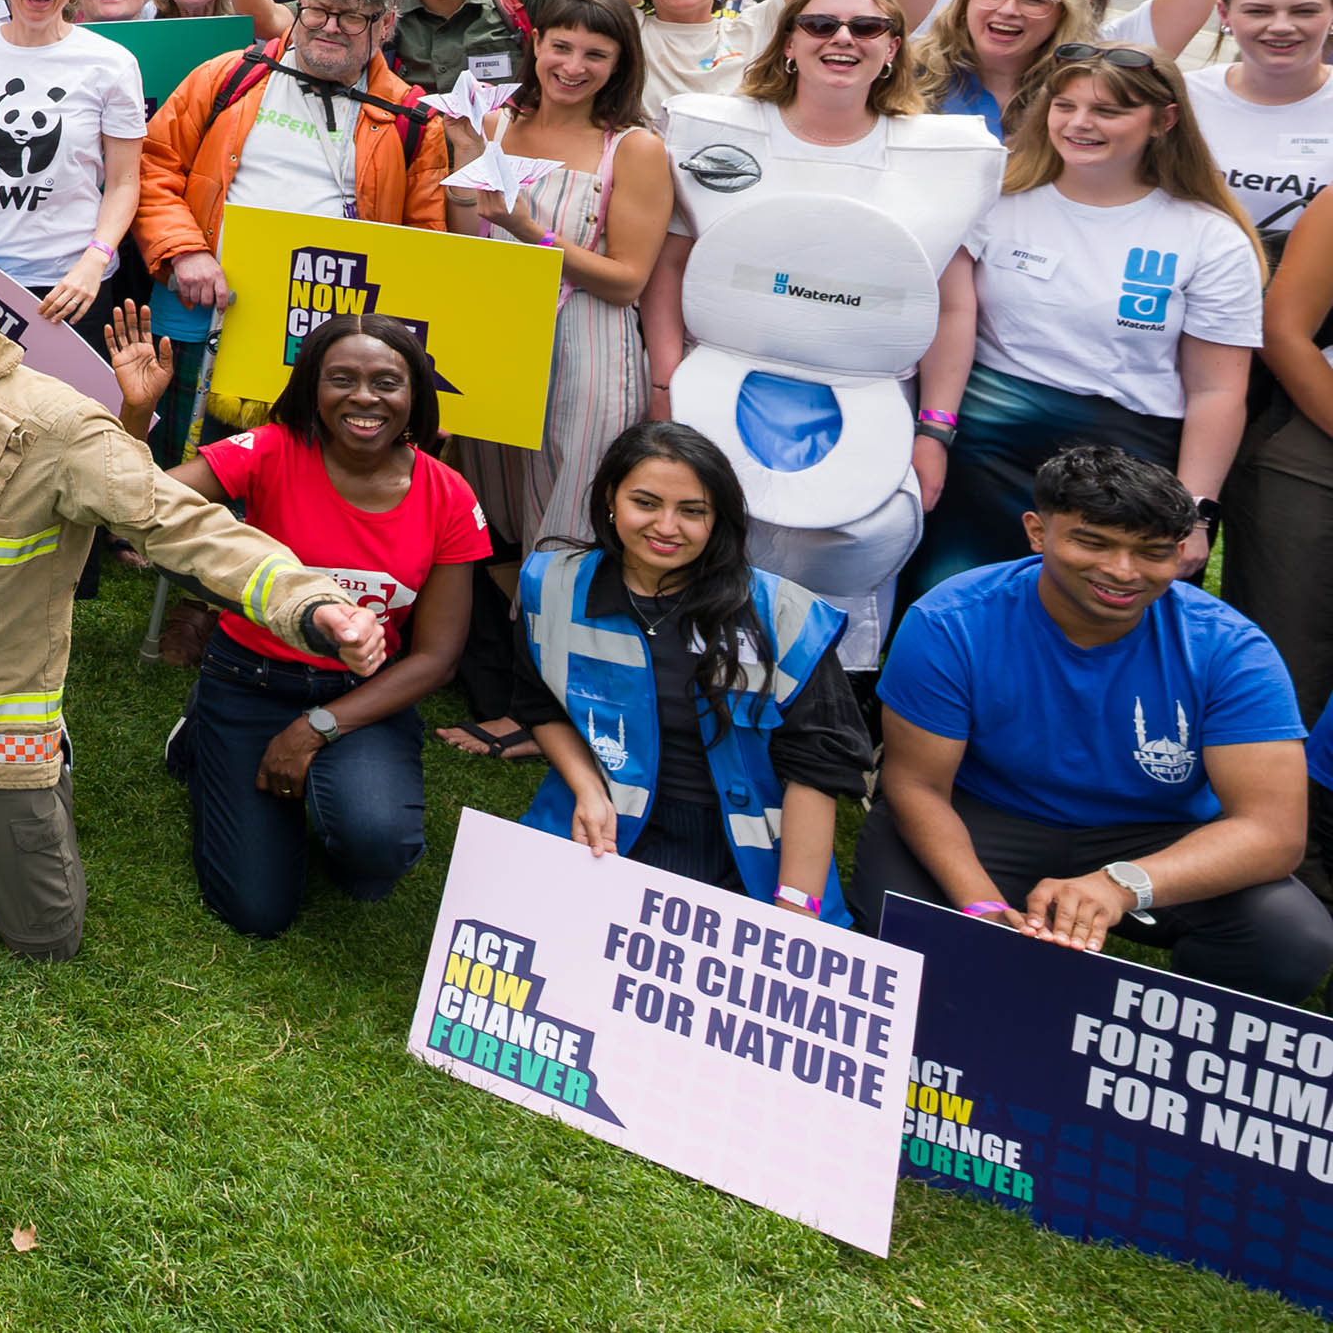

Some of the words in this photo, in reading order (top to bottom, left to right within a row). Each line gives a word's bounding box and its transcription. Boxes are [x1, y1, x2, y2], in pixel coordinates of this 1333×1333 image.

[788, 285, 861, 306] WaterAid
[1117, 319, 1165, 331] WaterAid
[446, 954, 531, 1010] NOW
[451, 929, 525, 974] ACT
[641, 888, 723, 949] FOR
[732, 908, 898, 1009] PEOPLE
[438, 987, 582, 1065] CHANGE
[603, 923, 687, 987] FOR
[697, 950, 891, 1059] CLIMATE
[430, 1017, 591, 1108] FOREVER
[612, 974, 694, 1037] FOR
[704, 1001, 886, 1110] NATURE
